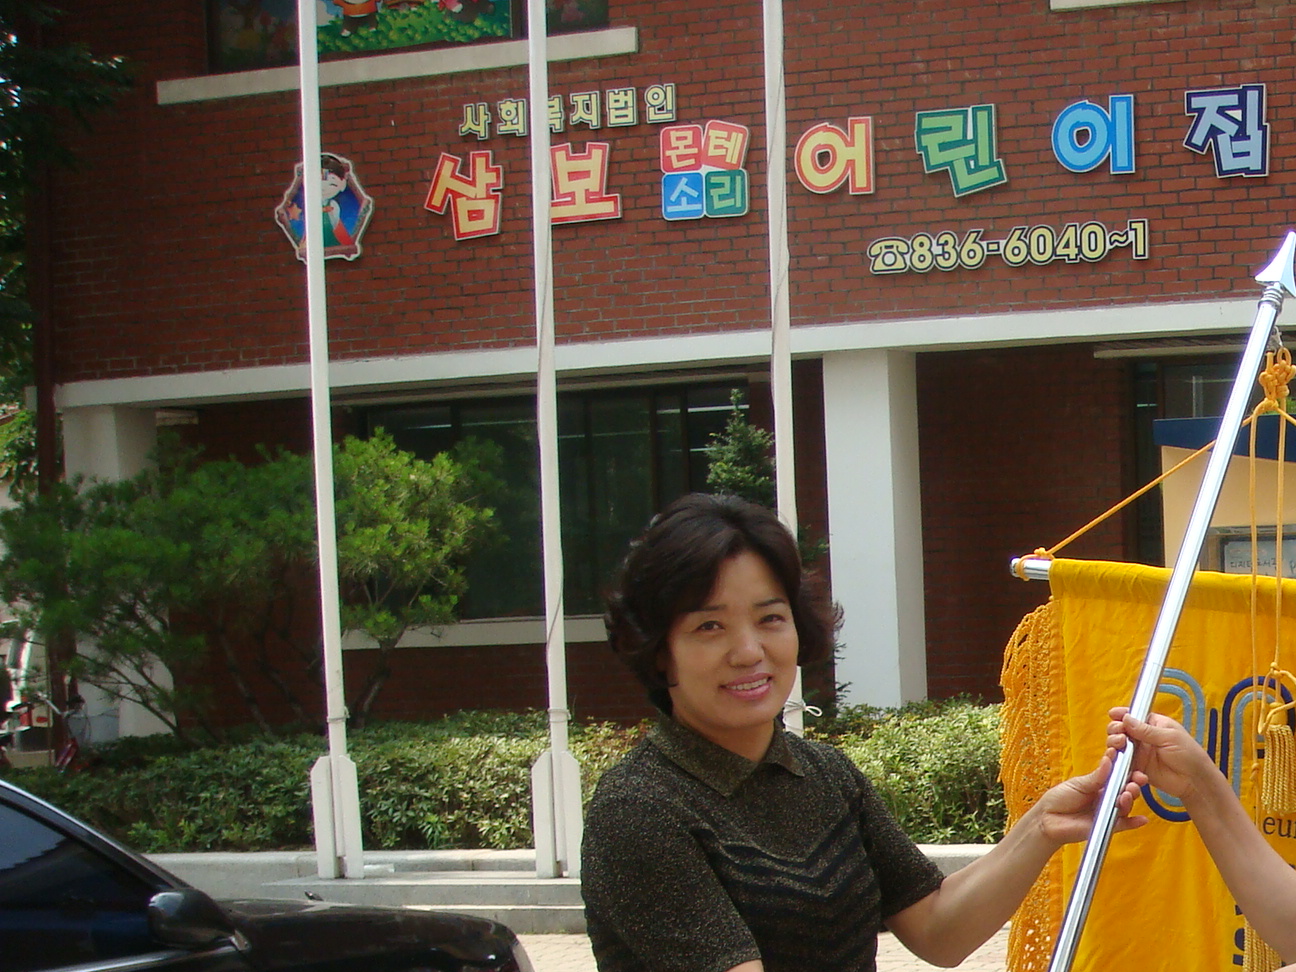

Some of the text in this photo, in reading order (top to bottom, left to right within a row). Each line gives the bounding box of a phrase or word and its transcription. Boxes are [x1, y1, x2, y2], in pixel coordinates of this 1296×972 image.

[661, 121, 749, 173] 몬테
[795, 84, 1271, 198] 어린이집
[424, 142, 622, 241] 삼보
[662, 170, 749, 220] 소리
